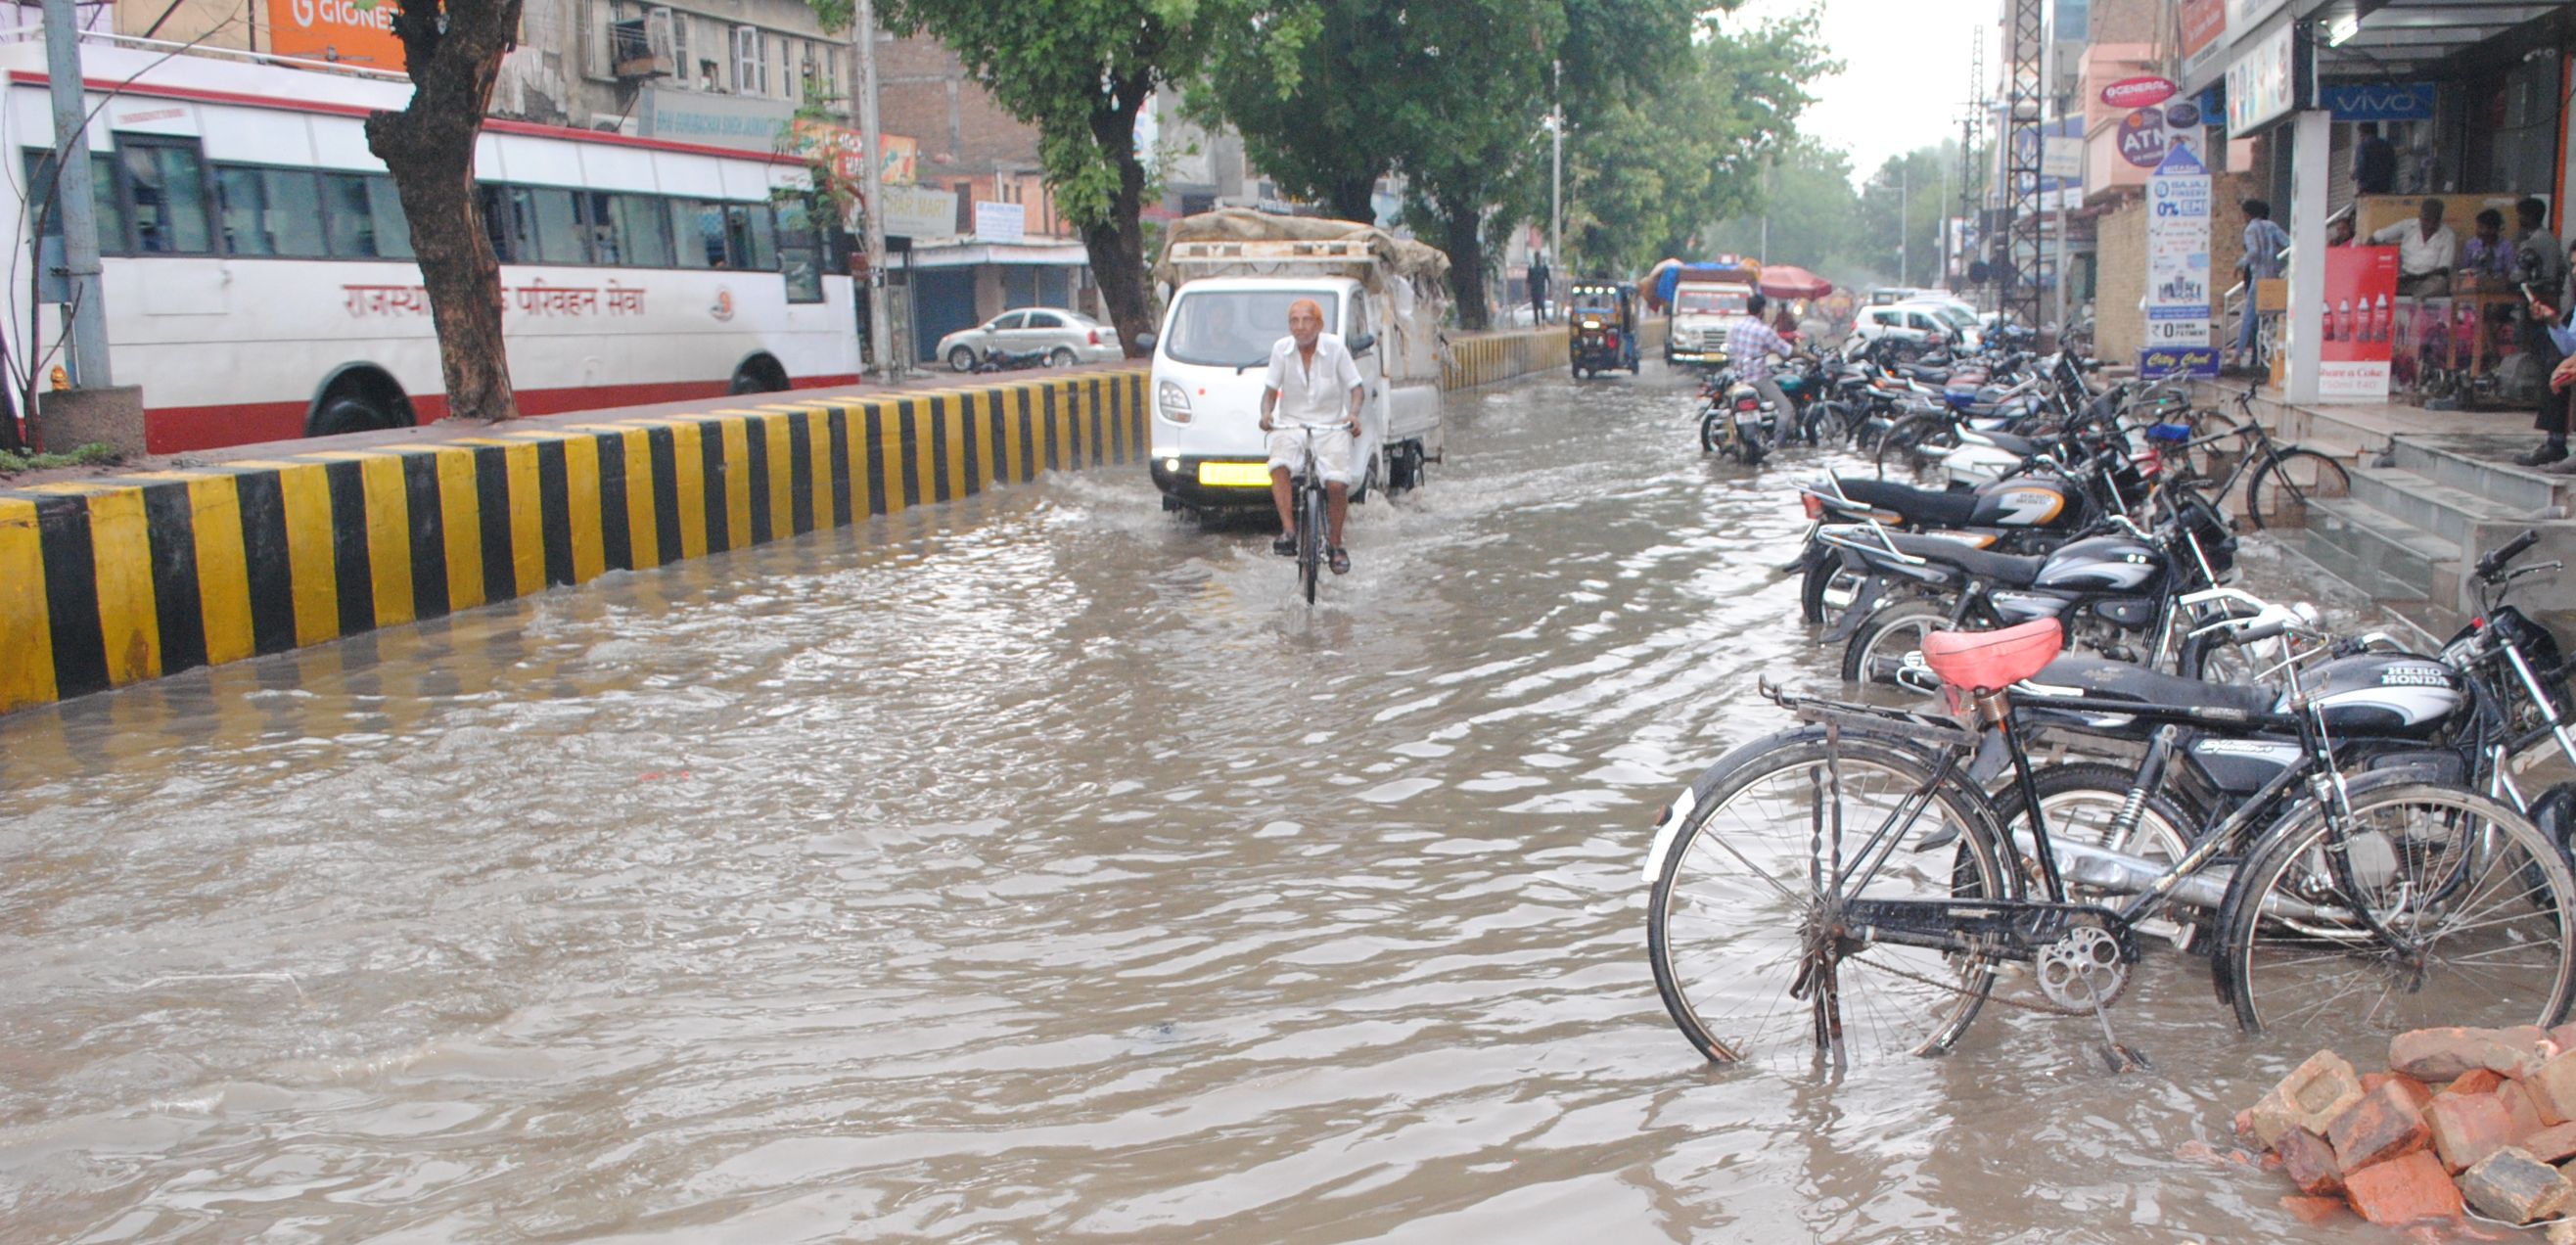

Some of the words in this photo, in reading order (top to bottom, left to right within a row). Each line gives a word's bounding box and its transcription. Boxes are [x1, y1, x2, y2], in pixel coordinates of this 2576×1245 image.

[2157, 202, 2179, 216] 0%
[516, 277, 598, 317] परिवहन
[605, 279, 646, 316] सेवा
[2387, 667, 2442, 676] HERO
[2381, 674, 2451, 686] HONDA
